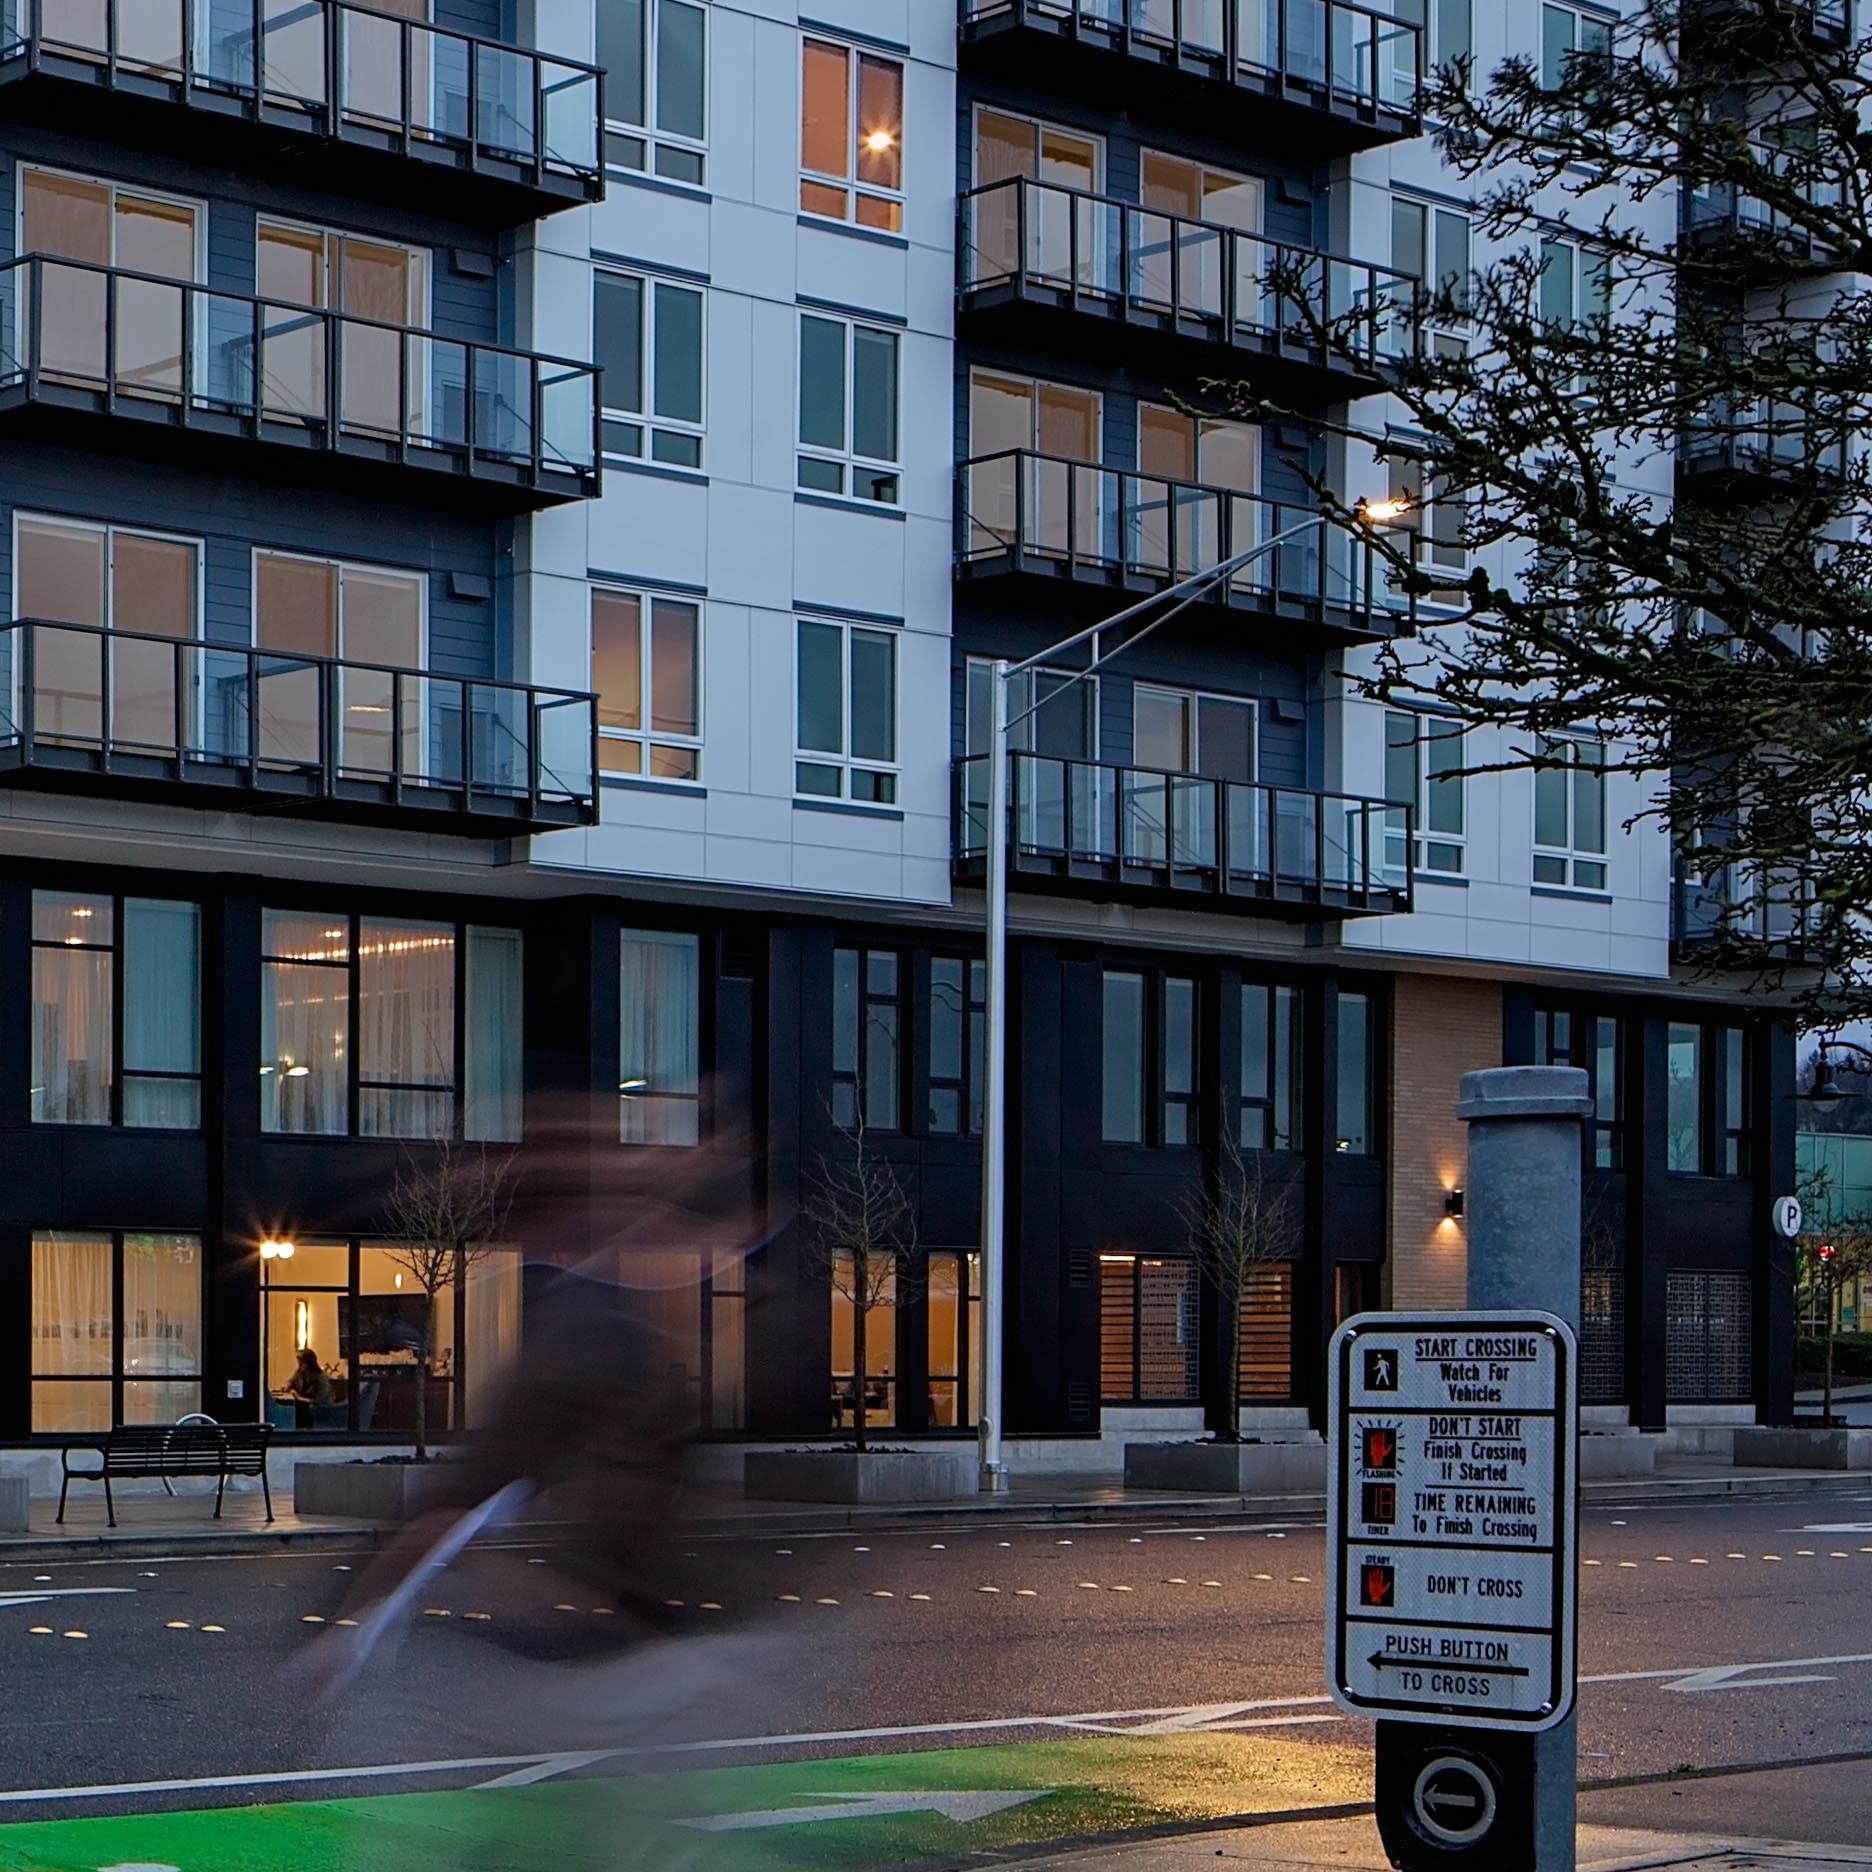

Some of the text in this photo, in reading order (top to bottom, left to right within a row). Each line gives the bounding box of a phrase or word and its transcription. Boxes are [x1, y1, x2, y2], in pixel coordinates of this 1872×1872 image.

[1787, 1205, 1798, 1228] P
[1415, 1338, 1537, 1357] START CROSSING
[1440, 1363, 1510, 1381] Watch For
[1448, 1384, 1502, 1403] Vehicles
[1429, 1417, 1522, 1437] DON'T START
[1424, 1441, 1527, 1466] Finish Crossing
[1442, 1463, 1507, 1482] If Started
[1414, 1493, 1536, 1516] TIME REMAINING
[1412, 1514, 1538, 1543] To Finish Crossing
[1365, 1554, 1391, 1566] STEADY
[1427, 1574, 1523, 1599] DON'T CROSS
[1385, 1635, 1509, 1661] PUSH BUTTON
[1401, 1671, 1490, 1696] TO CROSS
